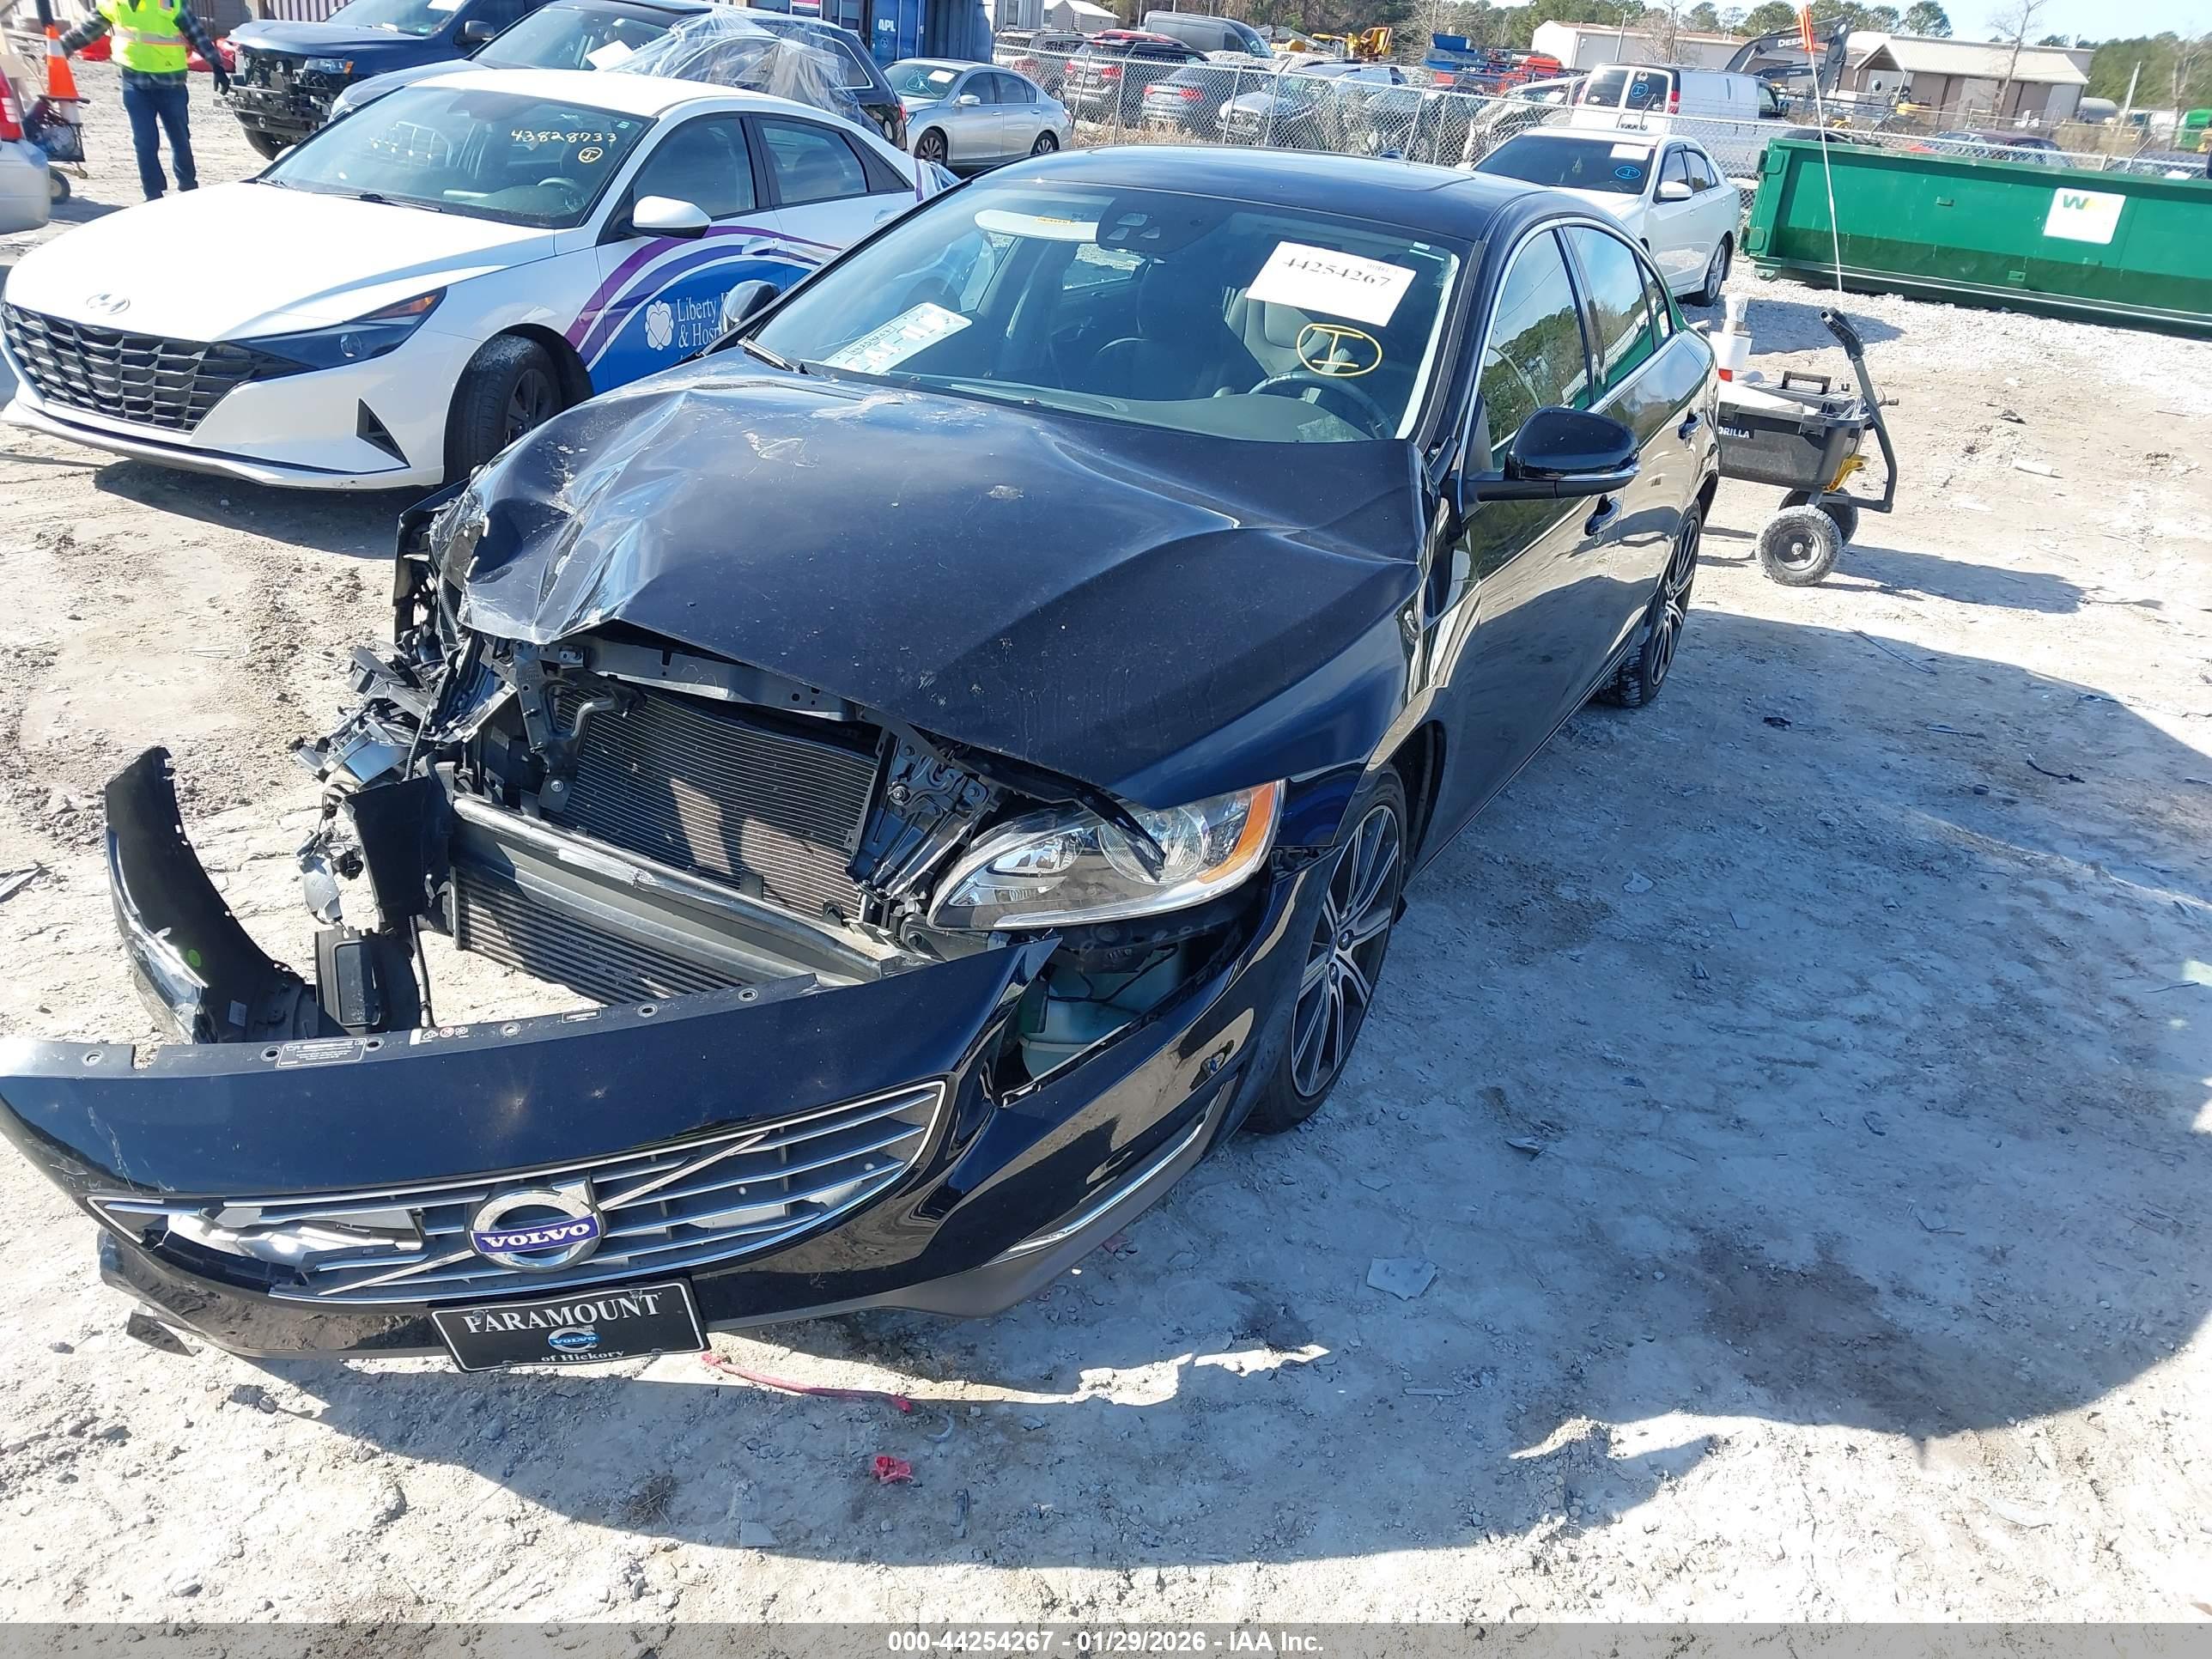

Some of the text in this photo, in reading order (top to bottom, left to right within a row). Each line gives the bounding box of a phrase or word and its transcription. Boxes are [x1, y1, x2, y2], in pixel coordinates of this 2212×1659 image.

[878, 18, 896, 33] APL
[510, 130, 617, 143] 43828733
[1283, 258, 1391, 287] 44254267
[677, 296, 717, 324] Liberty
[678, 324, 690, 349] &
[480, 1223, 591, 1249] VOLVO
[461, 1291, 660, 1334] PARAMOUNT
[552, 1335, 597, 1345] VOLVO
[541, 1350, 624, 1363] of Hickory
